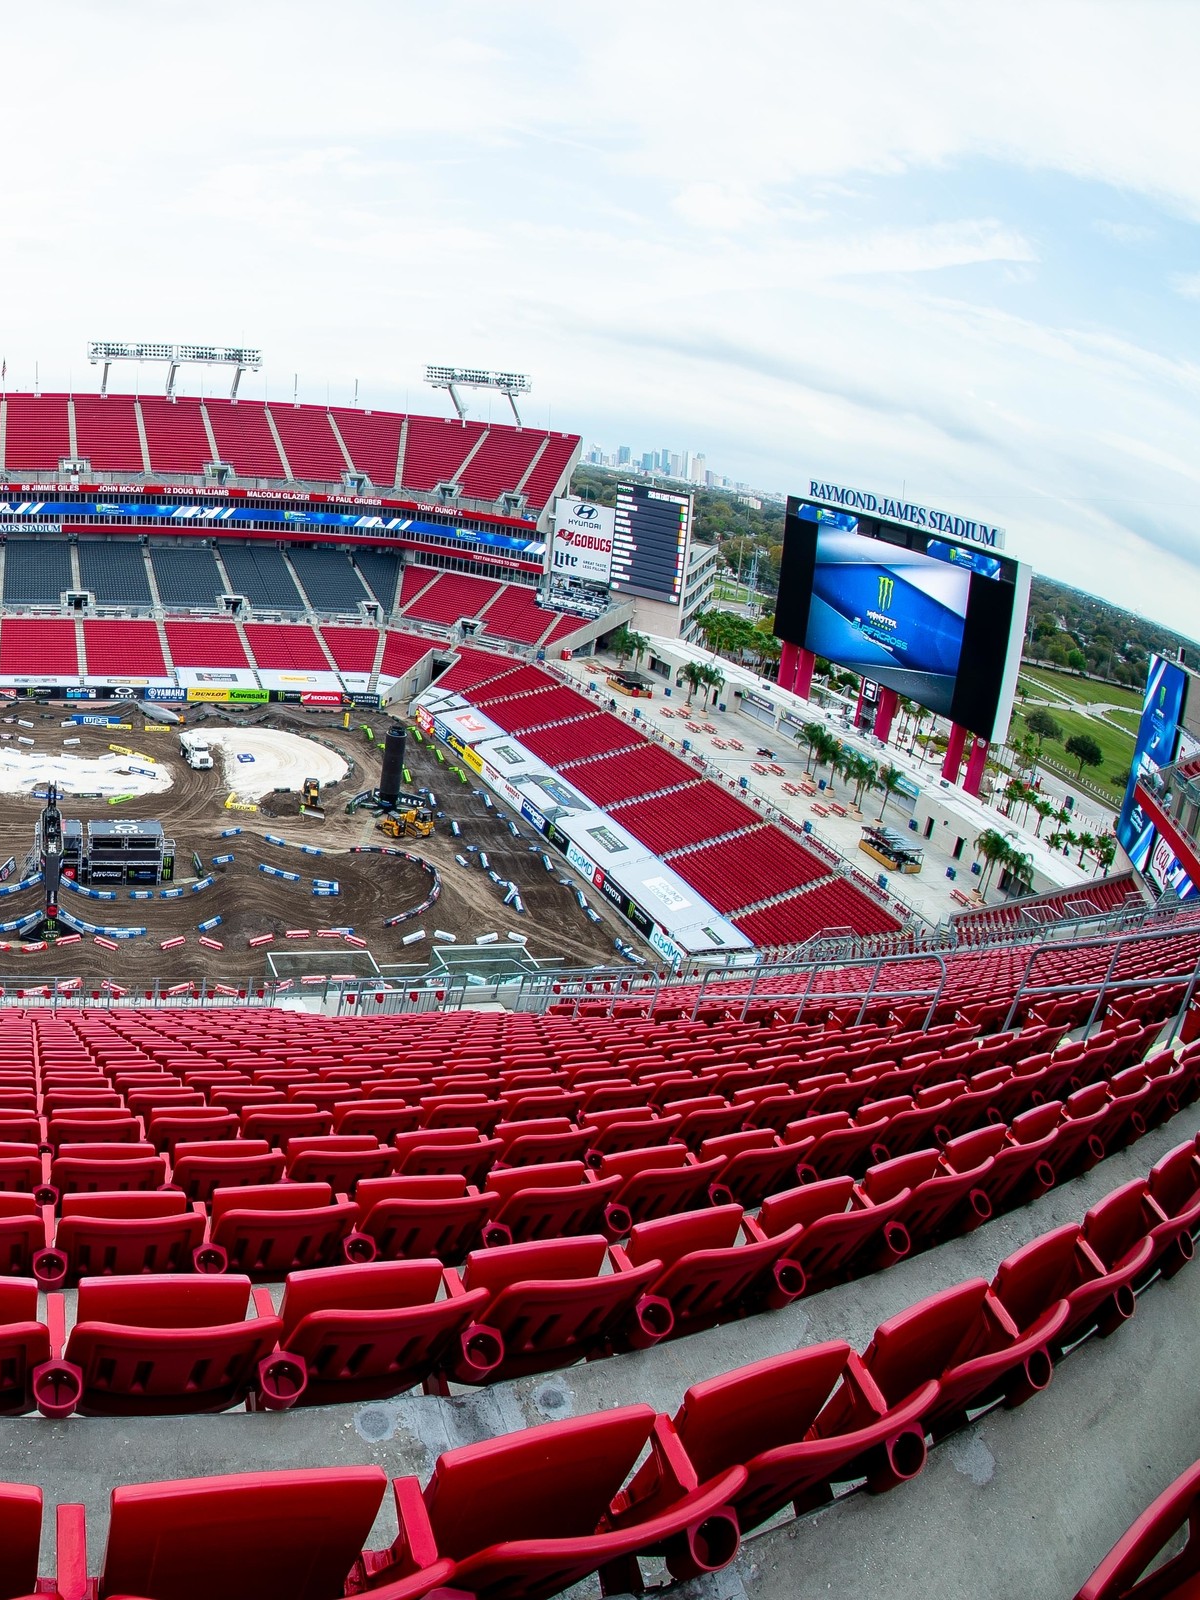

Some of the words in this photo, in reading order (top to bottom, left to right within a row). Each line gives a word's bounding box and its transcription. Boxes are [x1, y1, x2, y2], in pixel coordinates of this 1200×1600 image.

[417, 504, 434, 512] TONY
[435, 506, 458, 516] DUNGY
[810, 480, 876, 511] RAYMOND
[879, 498, 926, 526] JAMES
[928, 510, 997, 547] STADIUM
[568, 519, 601, 530] HYUNDAI
[554, 551, 578, 568] Lite
[866, 610, 897, 628] MONSTER
[230, 692, 268, 700] Kawasaki
[523, 801, 545, 824] COOPER
[569, 848, 592, 876] cbdMD
[603, 880, 621, 904] TOYOTA
